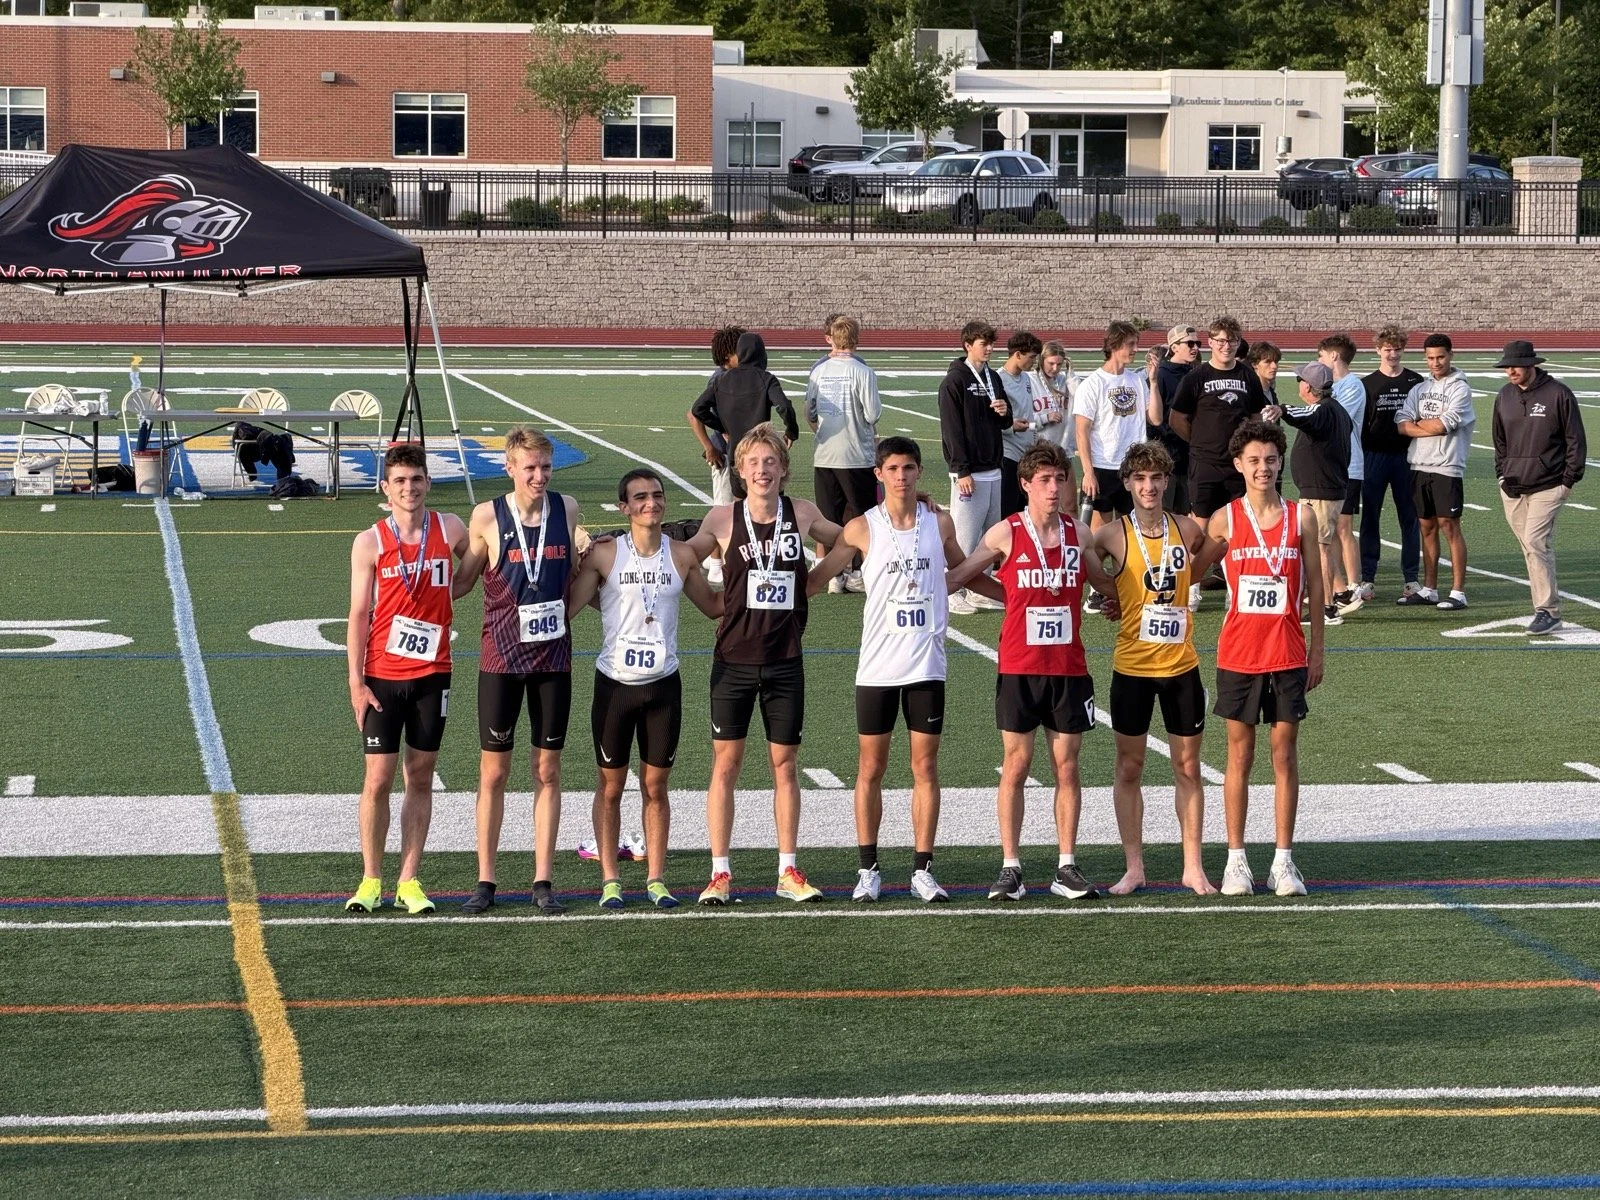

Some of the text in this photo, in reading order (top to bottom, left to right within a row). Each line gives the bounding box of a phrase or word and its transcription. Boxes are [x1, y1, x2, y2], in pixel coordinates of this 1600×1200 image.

[1178, 97, 1304, 106] Academic Innovation Cnter
[127, 265, 301, 277] ANVER
[1204, 379, 1248, 393] STONEHILL
[508, 545, 566, 563] WLOLE
[738, 539, 781, 562] READ
[784, 535, 798, 559] 3
[886, 558, 930, 574] LONMEDOW
[1067, 548, 1078, 571] 2
[1172, 547, 1184, 570] 8
[436, 561, 443, 584] 1
[619, 571, 672, 585] LONGMEAOW
[1017, 569, 1077, 588] NORTH
[756, 584, 787, 603] 823
[1248, 590, 1278, 608] 788
[529, 615, 558, 635] 949
[896, 609, 926, 627] 610
[1037, 621, 1062, 638] 751
[1148, 619, 1180, 637] 550
[398, 631, 429, 654] 783
[625, 649, 655, 668] 613
